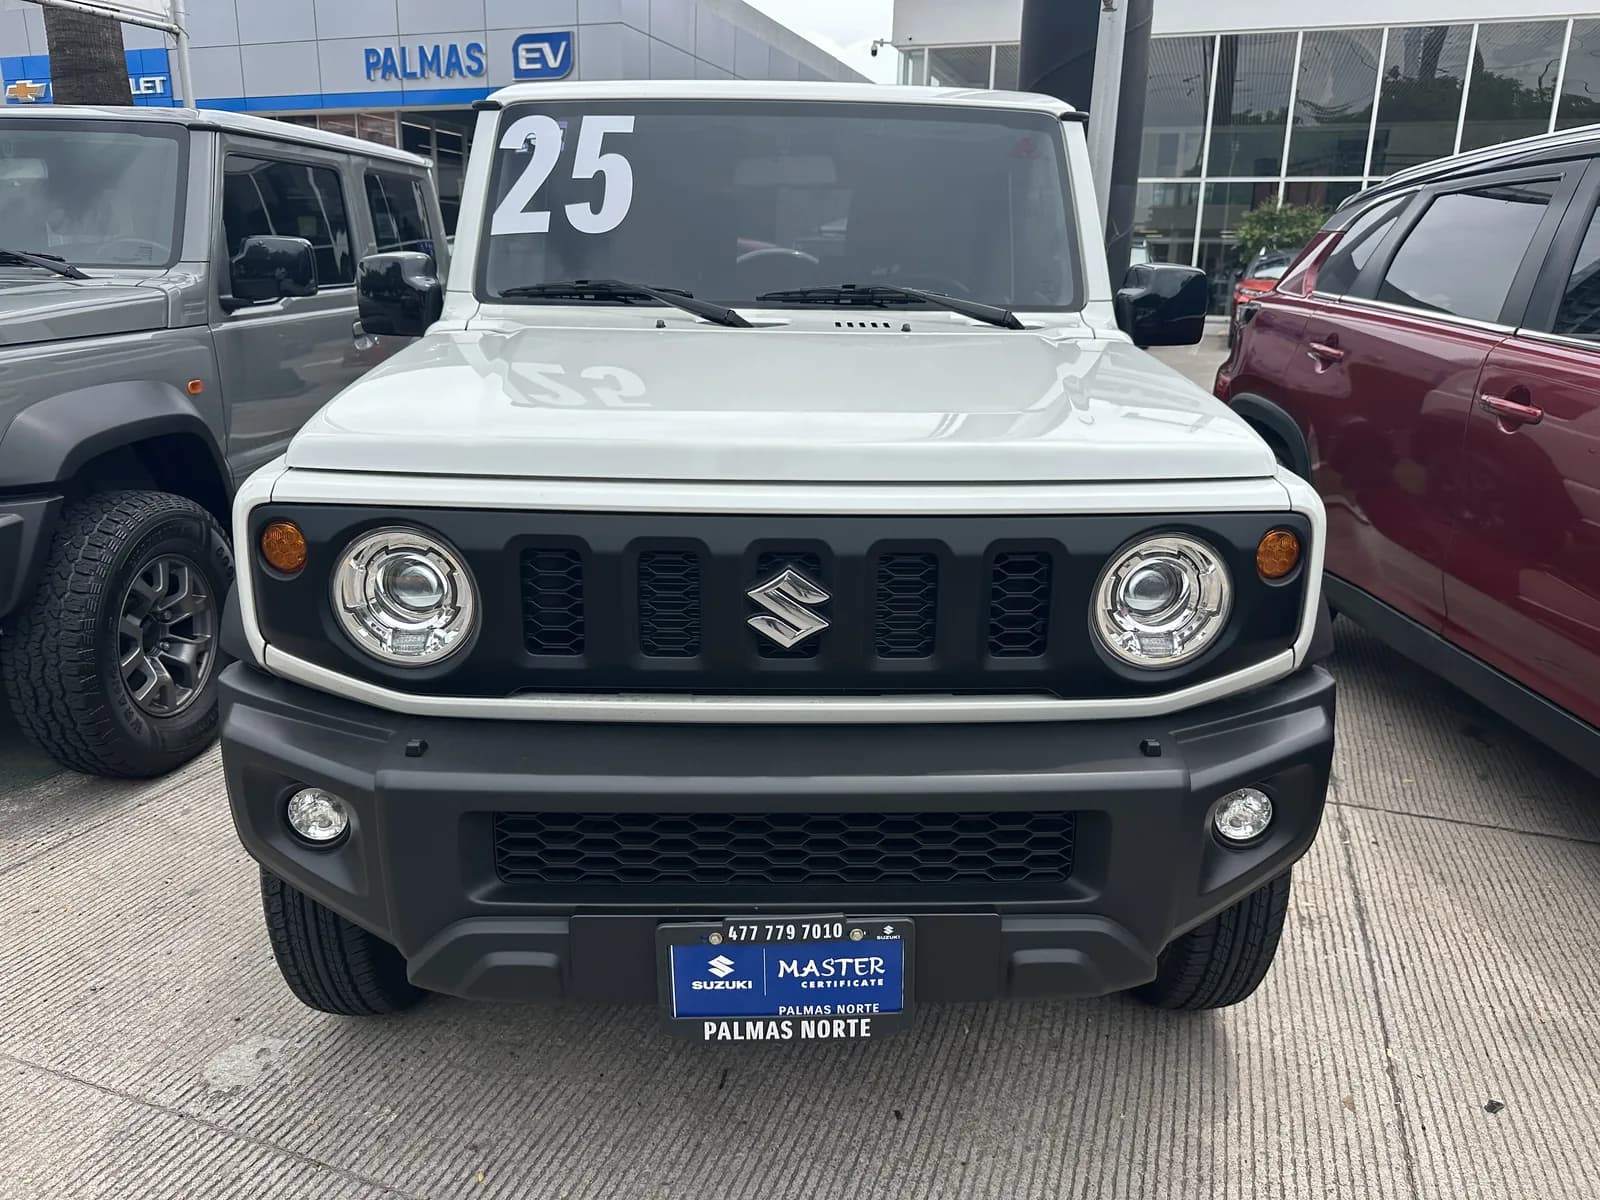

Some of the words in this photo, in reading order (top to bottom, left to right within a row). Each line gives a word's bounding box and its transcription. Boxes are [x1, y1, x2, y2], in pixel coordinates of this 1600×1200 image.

[364, 42, 487, 81] PALMAS
[517, 41, 568, 70] EV
[490, 114, 636, 236] 25
[728, 925, 758, 941] 477
[765, 923, 796, 941] 779
[802, 922, 843, 940] 7010
[777, 956, 886, 978] MASTER
[691, 980, 753, 990] SUZUKI
[801, 978, 884, 989] CERTIFICATE
[779, 1004, 832, 1016] PALMAS
[837, 1003, 880, 1015] NORTE
[703, 1020, 793, 1041] PALMAS
[801, 1018, 872, 1040] NORTE
